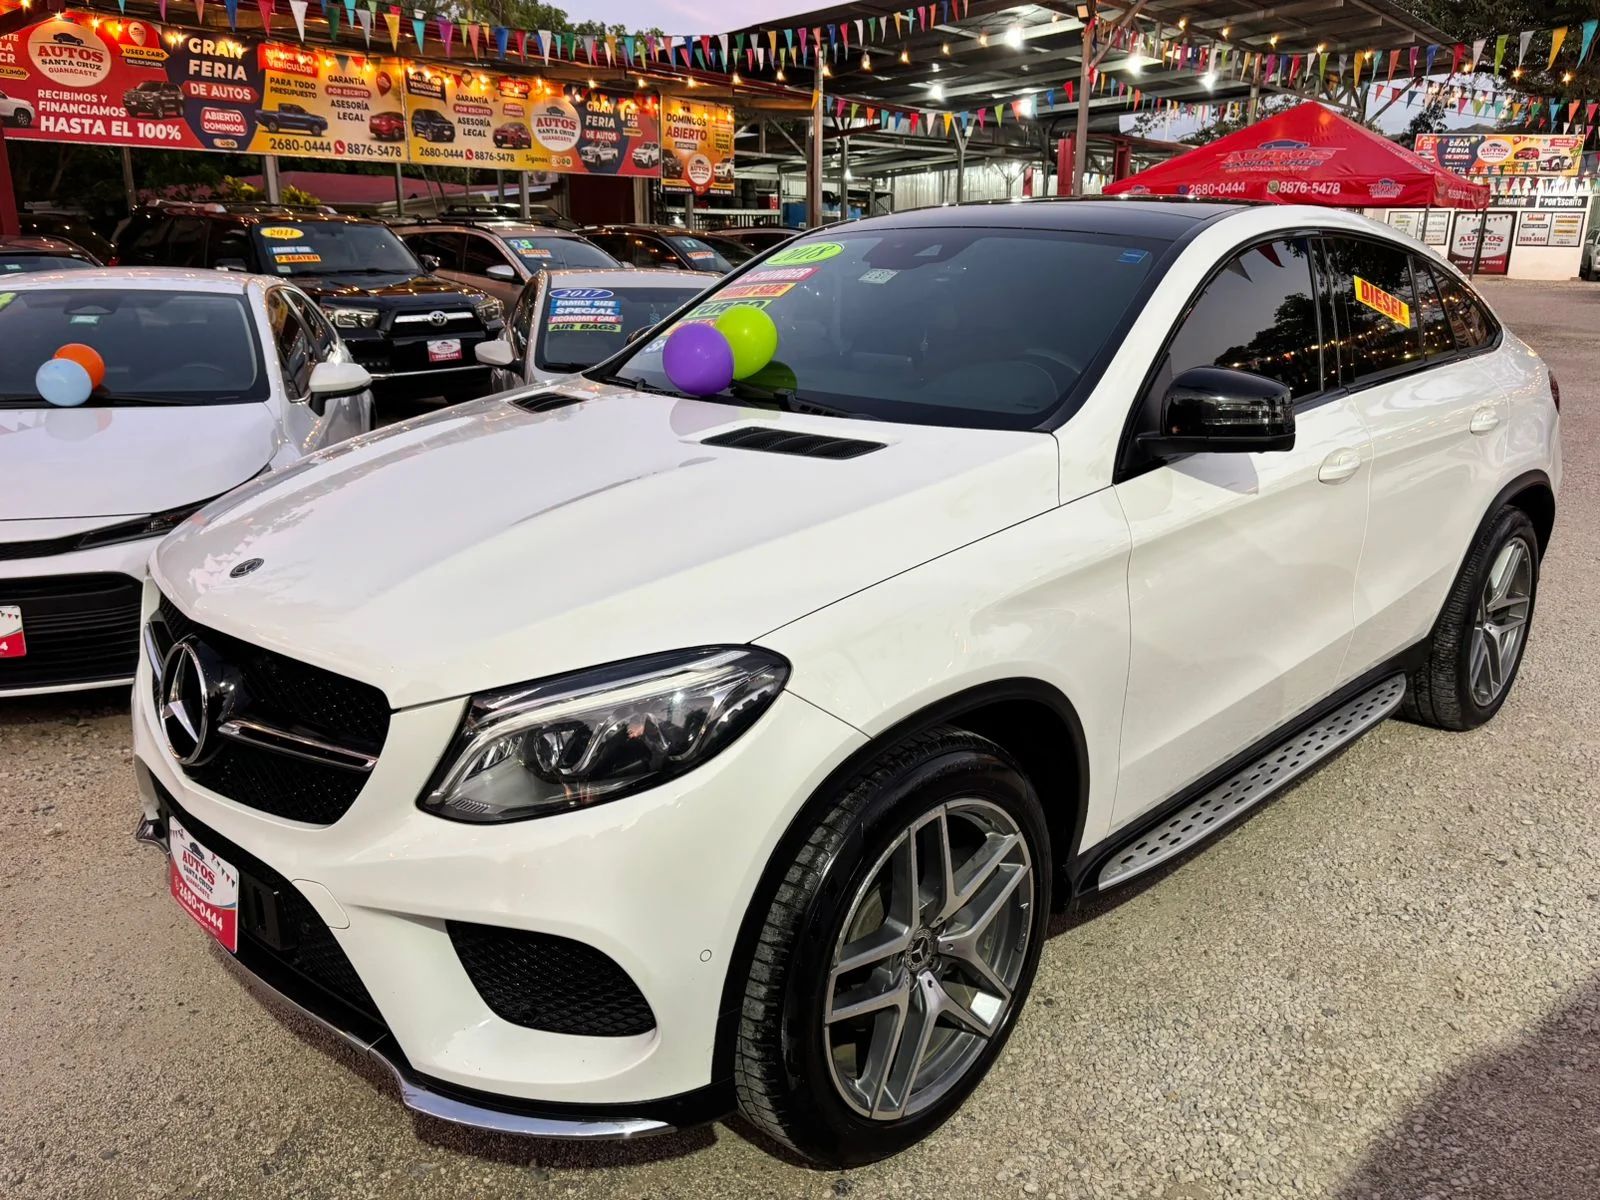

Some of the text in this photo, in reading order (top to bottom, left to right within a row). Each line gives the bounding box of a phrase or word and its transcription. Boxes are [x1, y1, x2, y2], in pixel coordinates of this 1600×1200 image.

[38, 45, 104, 63] AUTOS
[125, 48, 165, 58] USED CARS
[188, 37, 243, 59] GRAN
[42, 59, 102, 71] SANTA CRUZ
[188, 59, 248, 81] FERIA
[48, 67, 98, 78] GUANACASTE
[270, 77, 316, 90] PARA TODO
[328, 75, 366, 86] GARANTÍA
[37, 89, 108, 103] RECIBIMOS Y
[190, 83, 251, 100] DE AUTOS
[270, 86, 317, 99] PRESUPUESTO
[343, 88, 369, 97] ESCRITO
[330, 99, 370, 111] ASESORÍA
[456, 94, 489, 105] GARANTÍA
[38, 101, 127, 118] FINANCIAMOS
[468, 106, 491, 115] ESCRITO
[586, 100, 615, 114] GRAN
[205, 111, 242, 122] ABIERTO
[337, 111, 365, 122] LEGAL
[457, 117, 492, 128] ASESORÍA
[585, 115, 615, 128] FERIA
[666, 113, 707, 127] DOMINGOS
[40, 116, 181, 141] HASTA EL 100%
[203, 121, 245, 132] DOMINGOS
[536, 118, 577, 131] AUTOS
[462, 128, 487, 138] LEGAL
[538, 126, 576, 137] SANTA CRUZ
[586, 130, 594, 139] DE
[596, 131, 616, 141] AUTOS
[665, 125, 708, 141] ABIERTO
[269, 138, 402, 157] 2680-0444 8876-5478
[419, 146, 515, 163] 2680-0444 8876-5478
[1189, 182, 1341, 195] 2680-0444 8876-5478
[562, 290, 602, 298] 2017
[556, 299, 593, 307] FAMILY
[1361, 280, 1405, 322] DIESEL
[554, 307, 616, 315] SPECIAL
[551, 315, 618, 323] ECONOMY CAR
[578, 323, 618, 331] BAGS
[182, 850, 215, 885] AUTOS
[183, 864, 213, 893] SANTA CRUZ
[185, 874, 210, 899] GUANACASTE
[179, 883, 223, 931] 2680-0444
